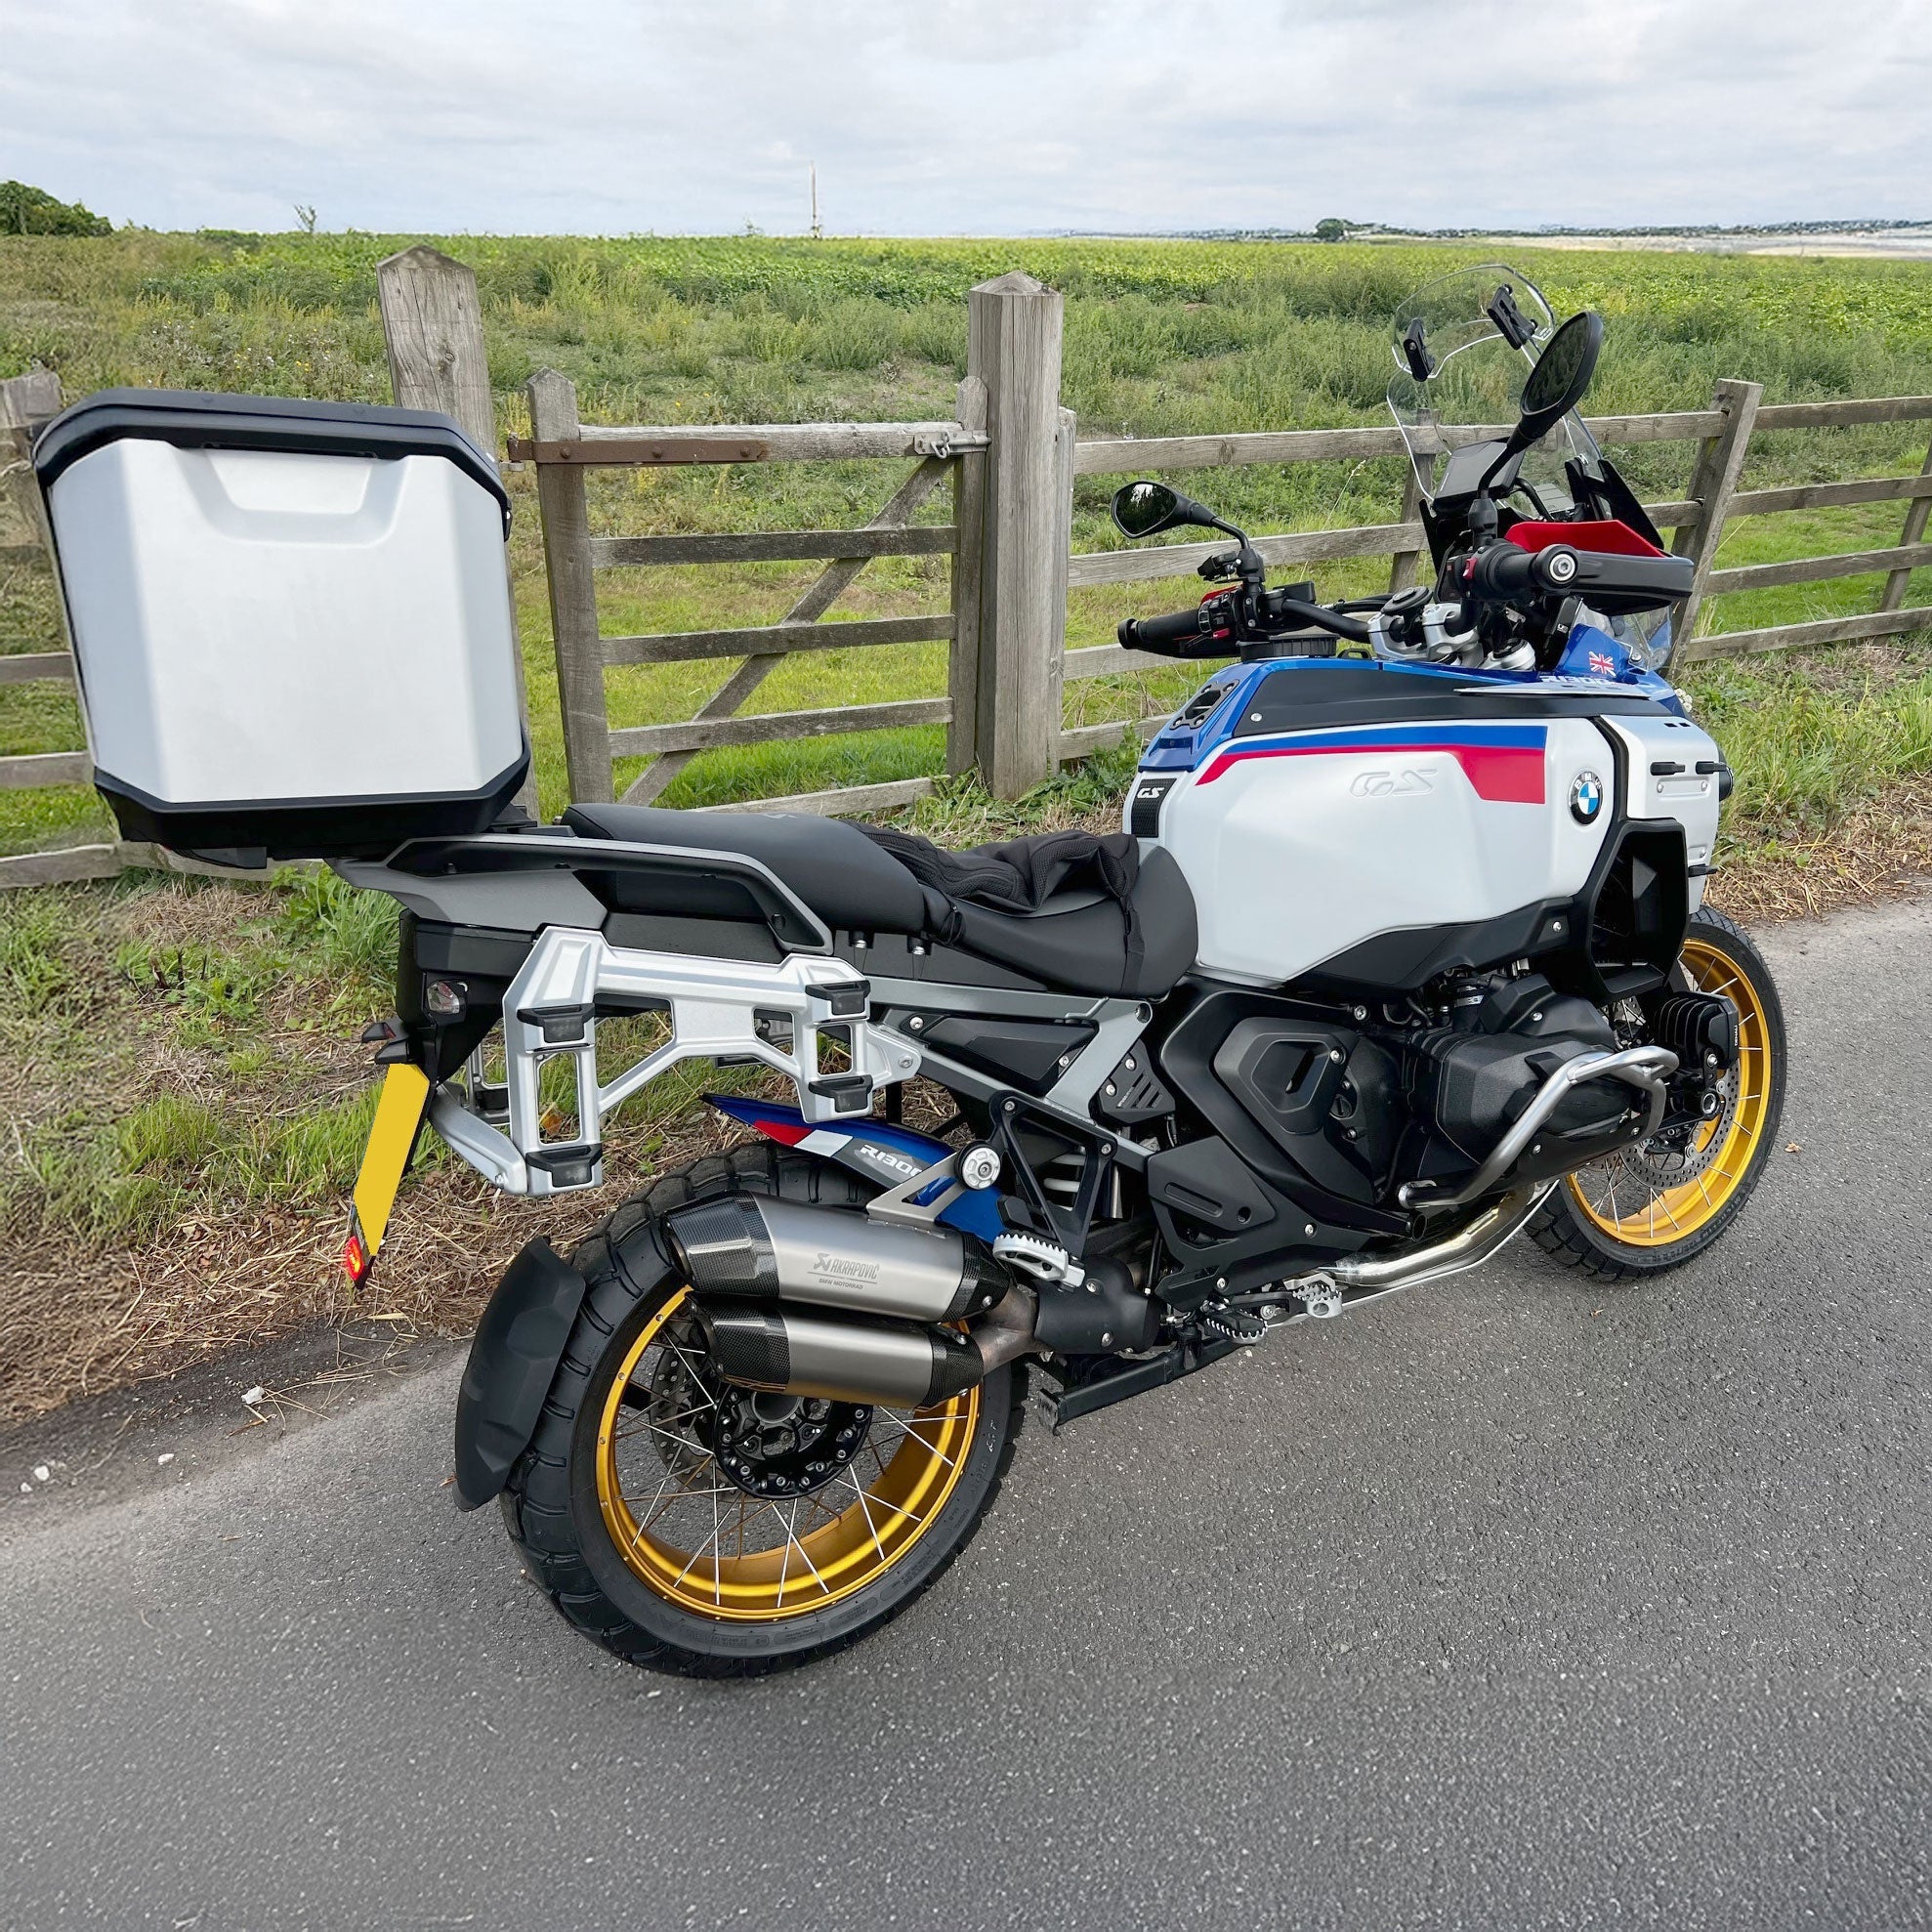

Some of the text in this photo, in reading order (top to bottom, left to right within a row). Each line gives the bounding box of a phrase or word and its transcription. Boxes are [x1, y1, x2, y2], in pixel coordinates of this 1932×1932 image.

[1349, 769, 1438, 797] GS
[1137, 787, 1165, 799] GS
[833, 1281, 863, 1289] MOTORRAD
